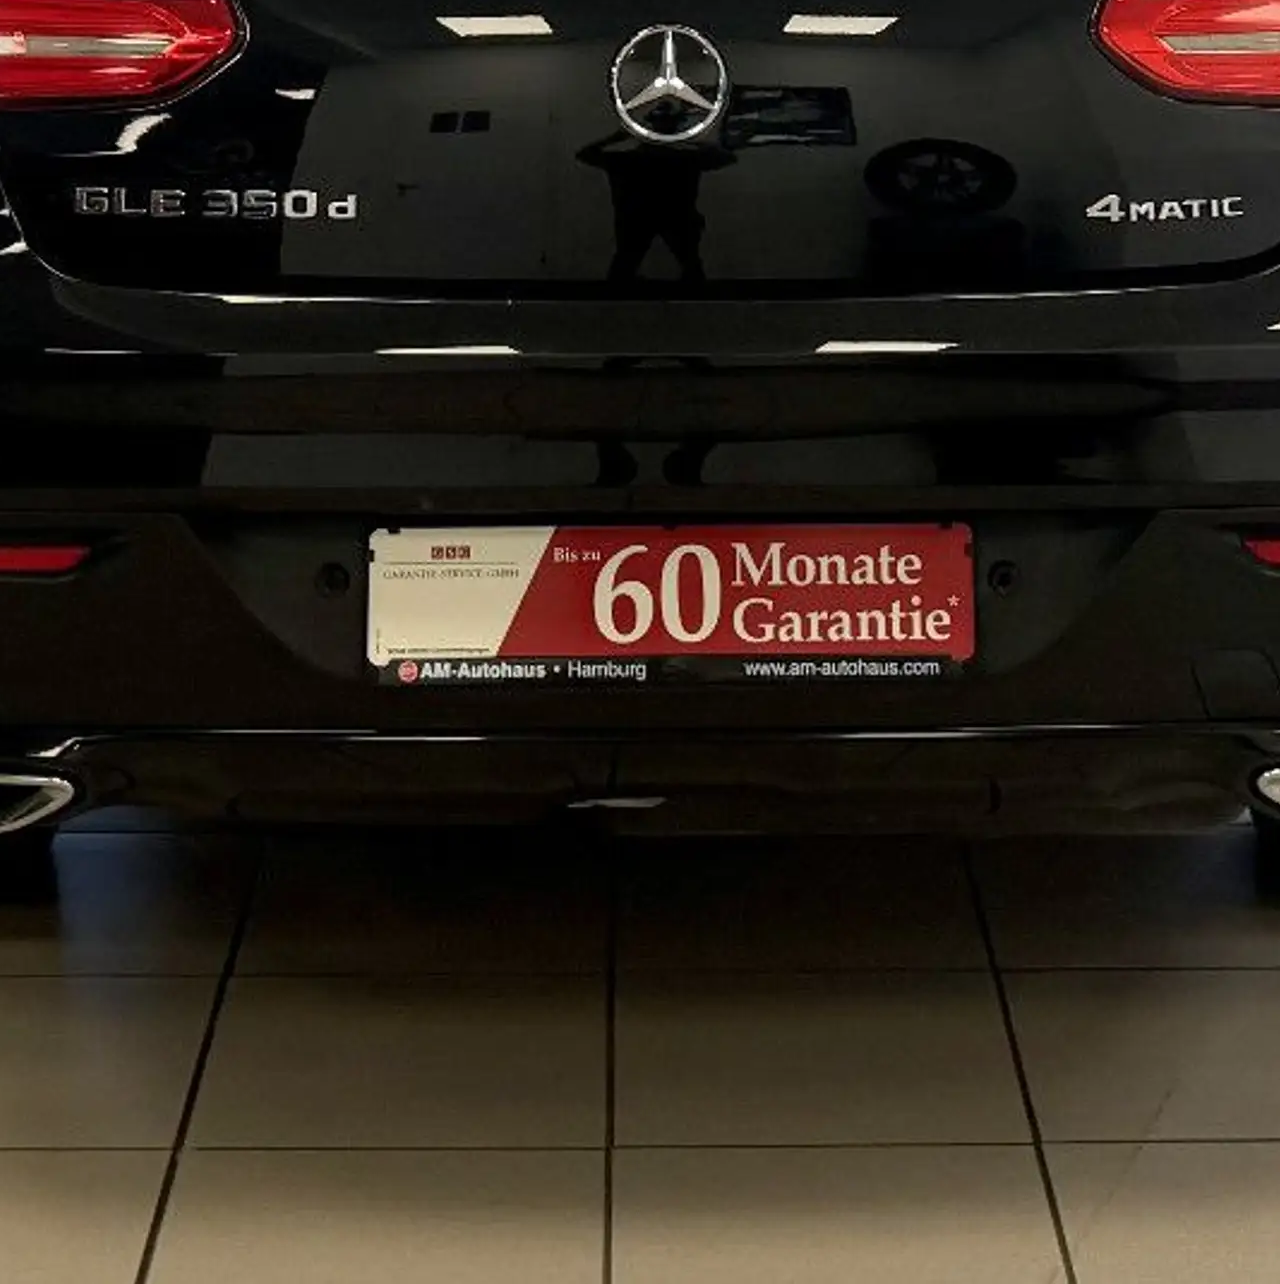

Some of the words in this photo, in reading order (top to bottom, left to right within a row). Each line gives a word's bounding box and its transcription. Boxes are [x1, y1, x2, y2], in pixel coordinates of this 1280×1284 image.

[74, 187, 186, 218] GLE
[1085, 193, 1245, 223] 4MATIC
[553, 546, 579, 562] Bis
[581, 550, 602, 563] zu
[592, 543, 722, 645] 60
[730, 542, 923, 587] Monate
[420, 661, 547, 679] AM-Autohaus
[566, 660, 648, 680] Hamburg
[743, 659, 941, 677] www.am-autohaus.com
